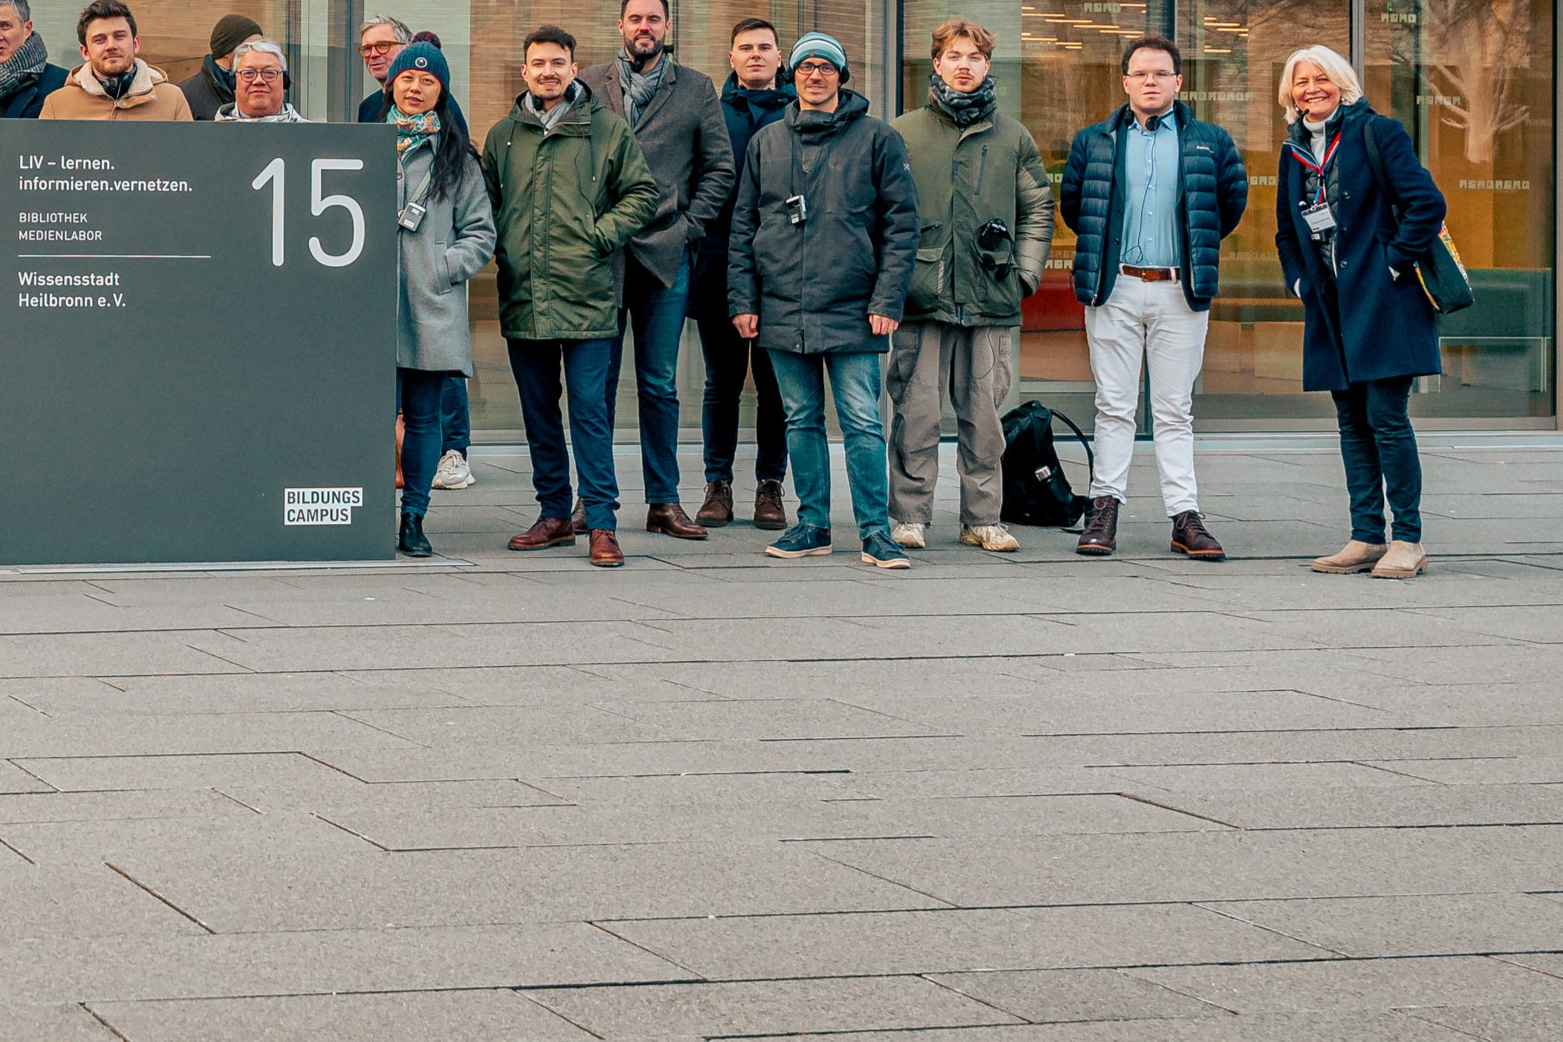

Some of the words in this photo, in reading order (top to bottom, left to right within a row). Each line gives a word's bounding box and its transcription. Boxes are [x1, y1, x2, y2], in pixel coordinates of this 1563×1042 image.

[19, 154, 44, 170] LIV
[60, 155, 116, 170] lernen.
[19, 175, 194, 192] informieren.vernetzen.
[19, 212, 88, 224] BIBLIOTHEK
[251, 157, 366, 268] 15
[18, 229, 103, 241] MEDIENLABOR
[17, 271, 121, 286] Wissensstadt
[18, 292, 93, 307] Heilbronn
[287, 490, 361, 505] BILDUNGS
[287, 508, 349, 523] CAMPUS
